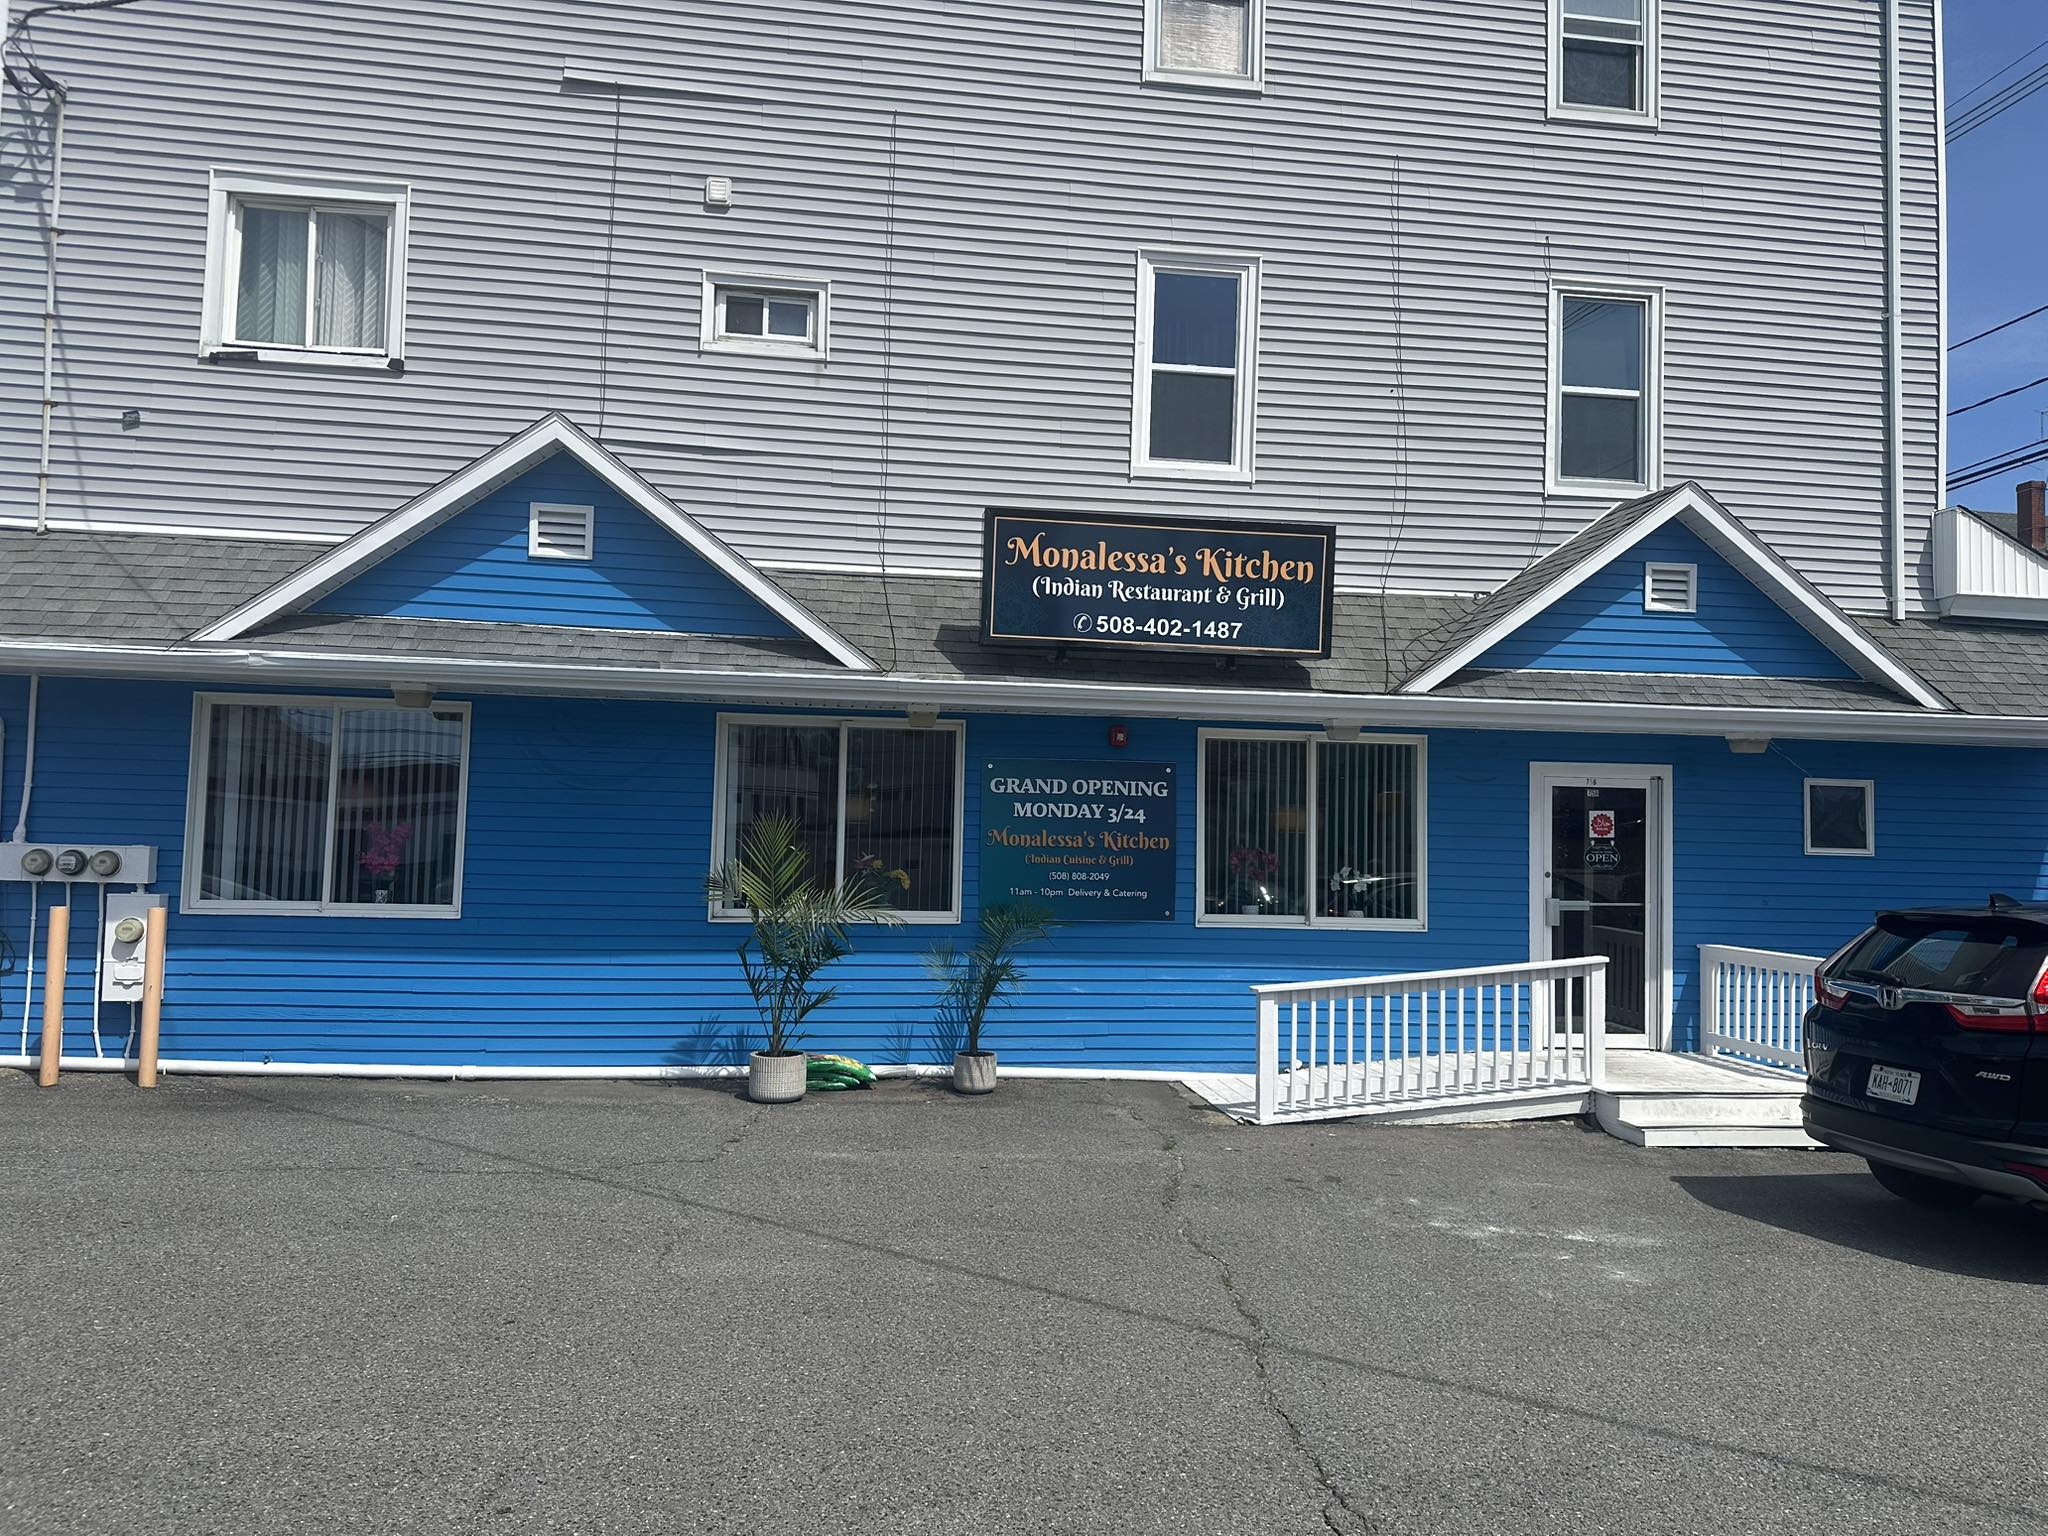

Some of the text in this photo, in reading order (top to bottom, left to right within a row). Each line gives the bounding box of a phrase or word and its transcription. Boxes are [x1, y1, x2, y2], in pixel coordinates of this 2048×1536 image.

[1005, 532, 1314, 584] Monalessa's Kitchen
[1032, 575, 1285, 610] (Indian Restaurant & Grill)
[1096, 615, 1243, 640] 508-402-1487
[990, 777, 1169, 797] GRAND OPENING
[1013, 802, 1146, 823] MONDAY 3/24
[986, 825, 1170, 851] Monalessa's Kitchen
[1025, 854, 1134, 867] (Indian Cuisine & Grill)
[1586, 853, 1618, 863] OPEN
[1049, 871, 1110, 881] (508) 808-2049
[1009, 887, 1032, 896] 11am
[1040, 887, 1064, 898] 10pm
[1068, 888, 1101, 898] Delivery
[1103, 888, 1110, 897] &
[1112, 888, 1148, 899] Catering
[1975, 1071, 2011, 1081] AWD
